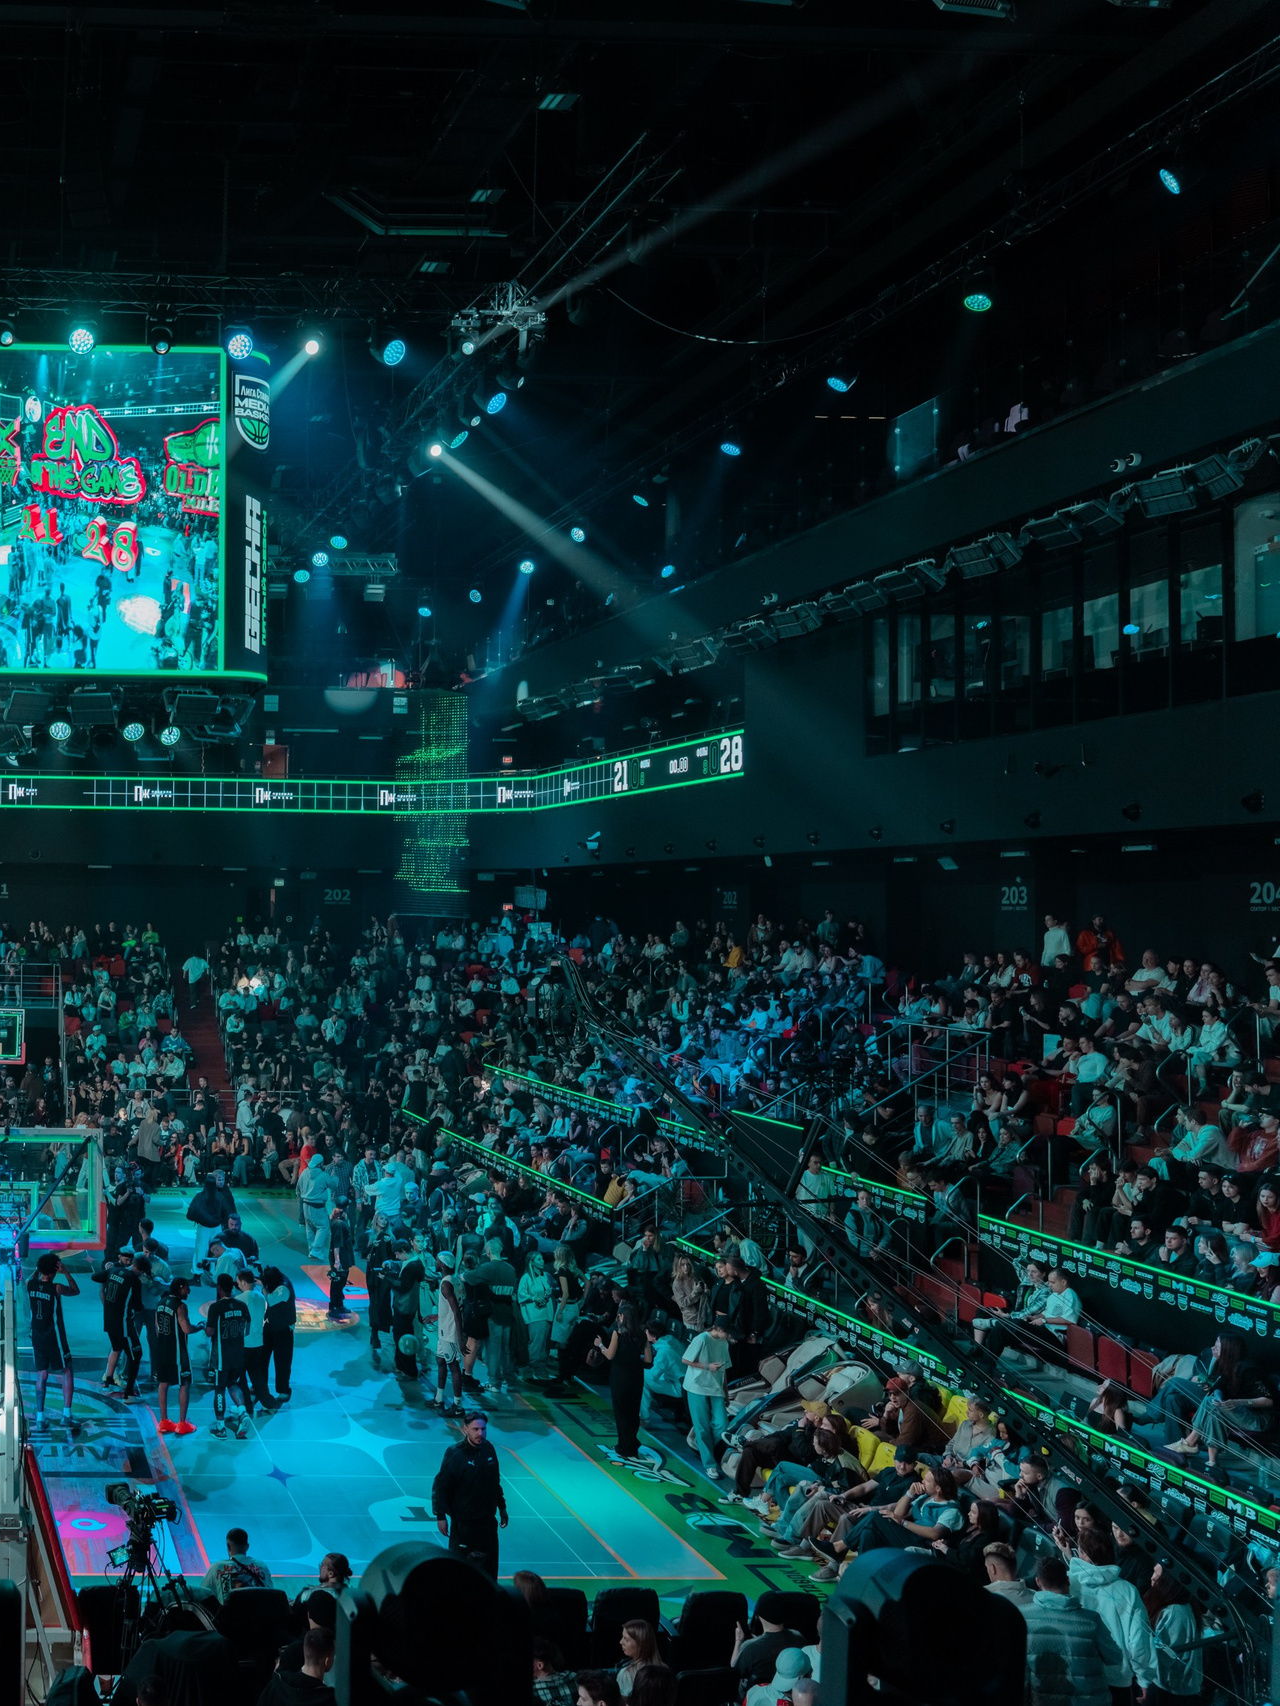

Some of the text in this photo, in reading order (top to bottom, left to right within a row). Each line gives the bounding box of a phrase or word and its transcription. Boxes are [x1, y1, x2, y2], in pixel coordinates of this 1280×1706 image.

[44, 408, 112, 462] END
[80, 463, 141, 496] GAME
[20, 503, 64, 545] 21
[82, 516, 139, 571] 28
[720, 735, 743, 774] 28
[614, 760, 628, 792] 21
[323, 888, 351, 901] 202
[722, 891, 737, 905] 202
[1001, 886, 1028, 905] 203
[1073, 1249, 1093, 1263] MB
[1171, 1280, 1195, 1295] MB
[1104, 1441, 1130, 1461] MB
[1227, 1498, 1257, 1520] MB
